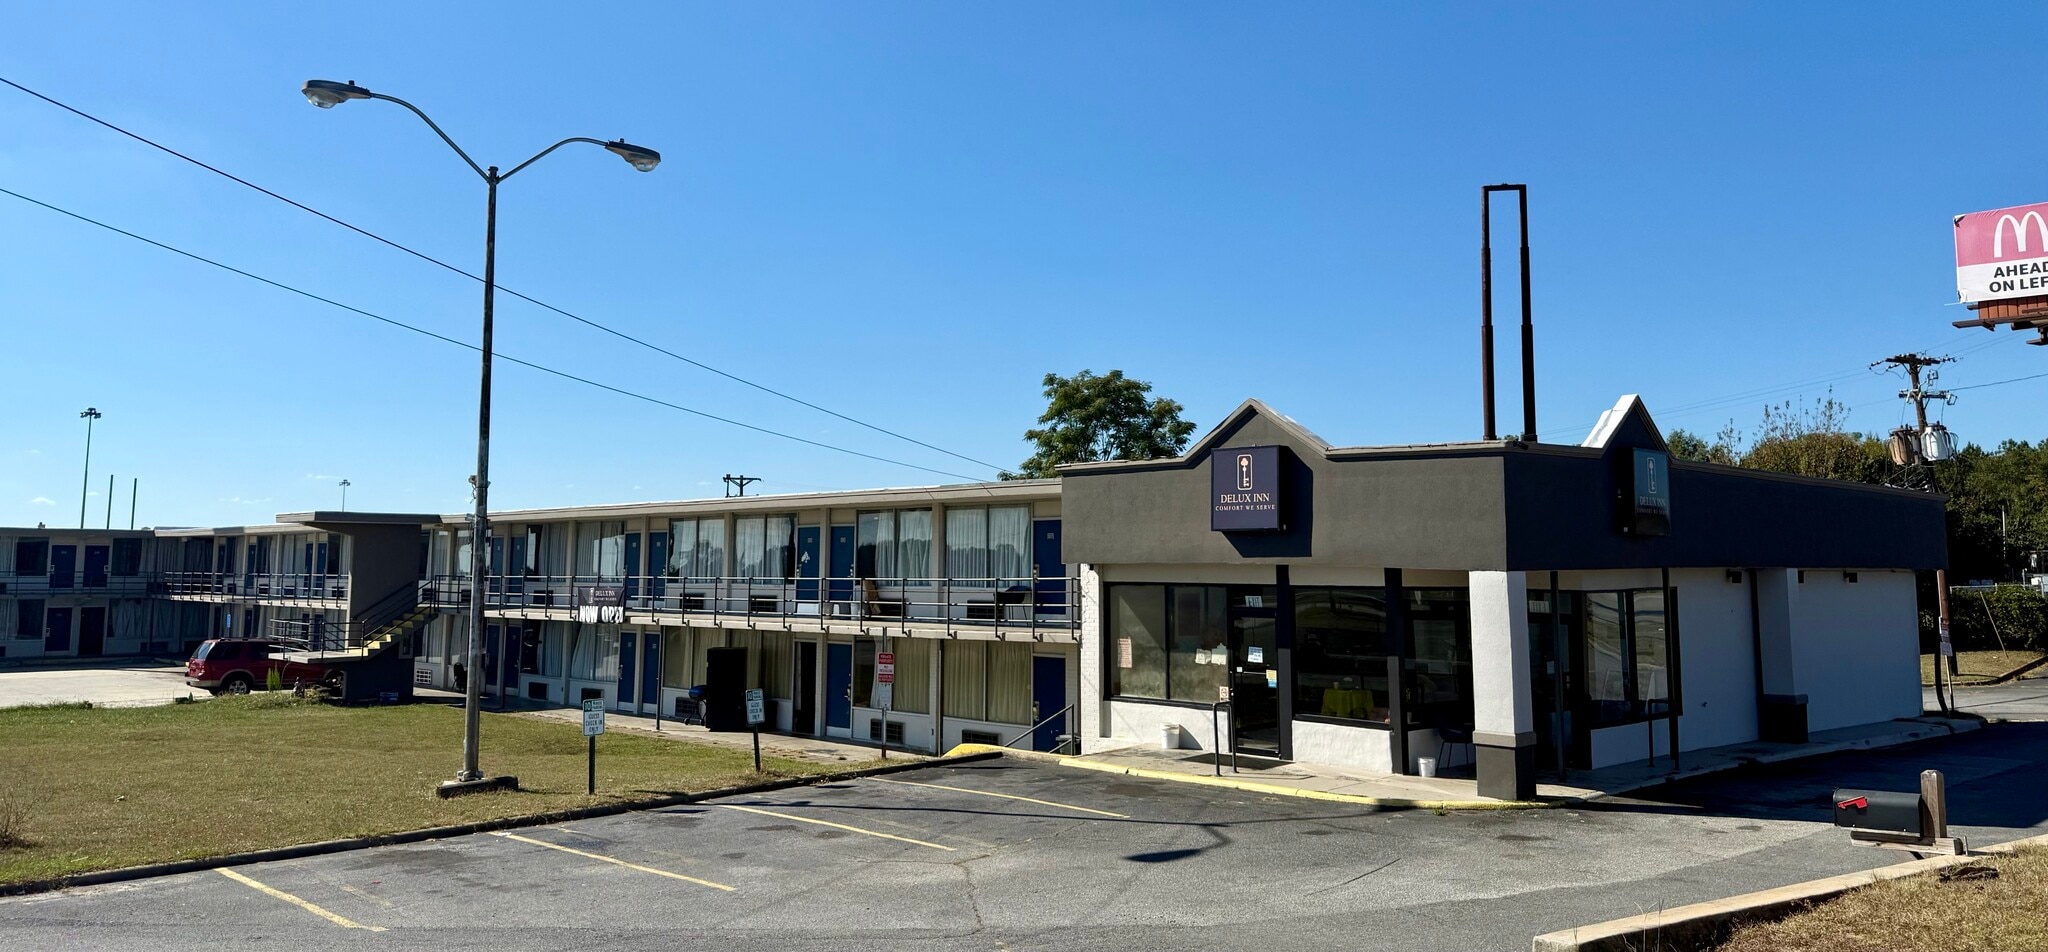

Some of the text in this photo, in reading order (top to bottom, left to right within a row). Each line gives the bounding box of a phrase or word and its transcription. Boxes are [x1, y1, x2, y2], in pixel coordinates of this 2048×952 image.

[1989, 280, 2014, 293] ON
[1220, 493, 1270, 503] DELUX INN
[579, 605, 599, 623] NOW
